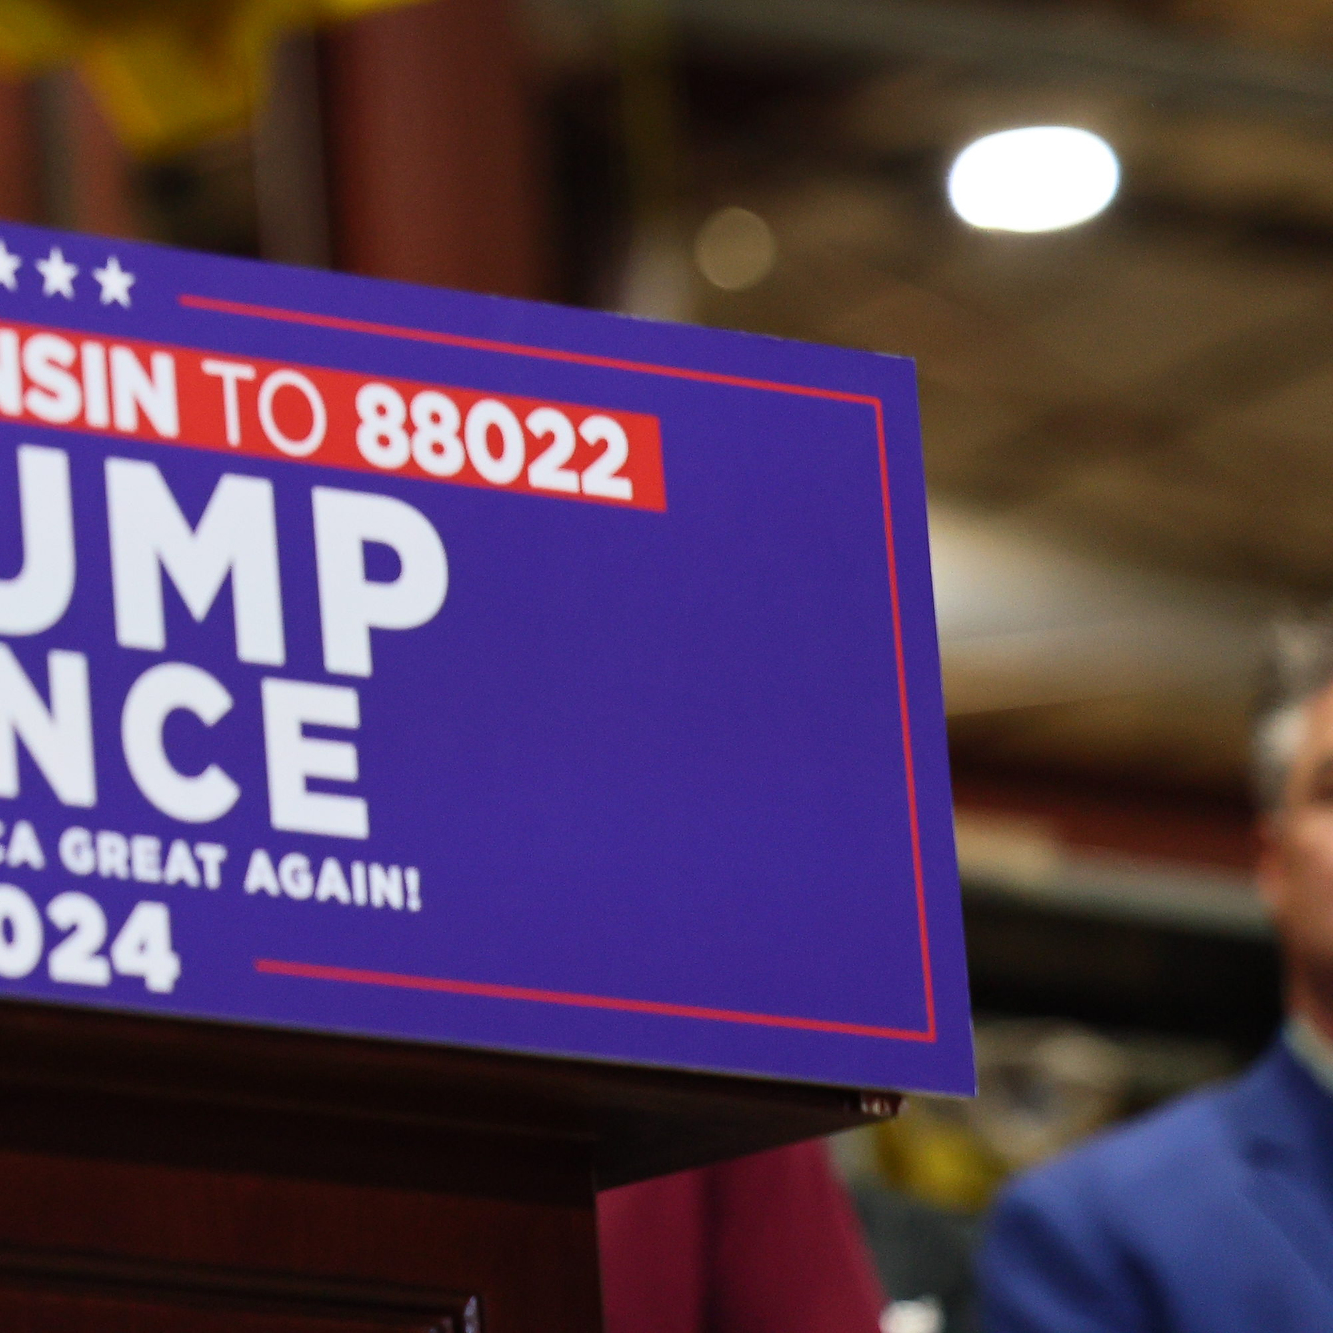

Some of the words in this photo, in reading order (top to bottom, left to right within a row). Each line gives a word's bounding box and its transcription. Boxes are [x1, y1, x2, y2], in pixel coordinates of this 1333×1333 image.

[201, 359, 327, 457] TO
[355, 383, 634, 501] 88022
[59, 827, 228, 893] GREAT
[244, 849, 422, 912] AGAIN!
